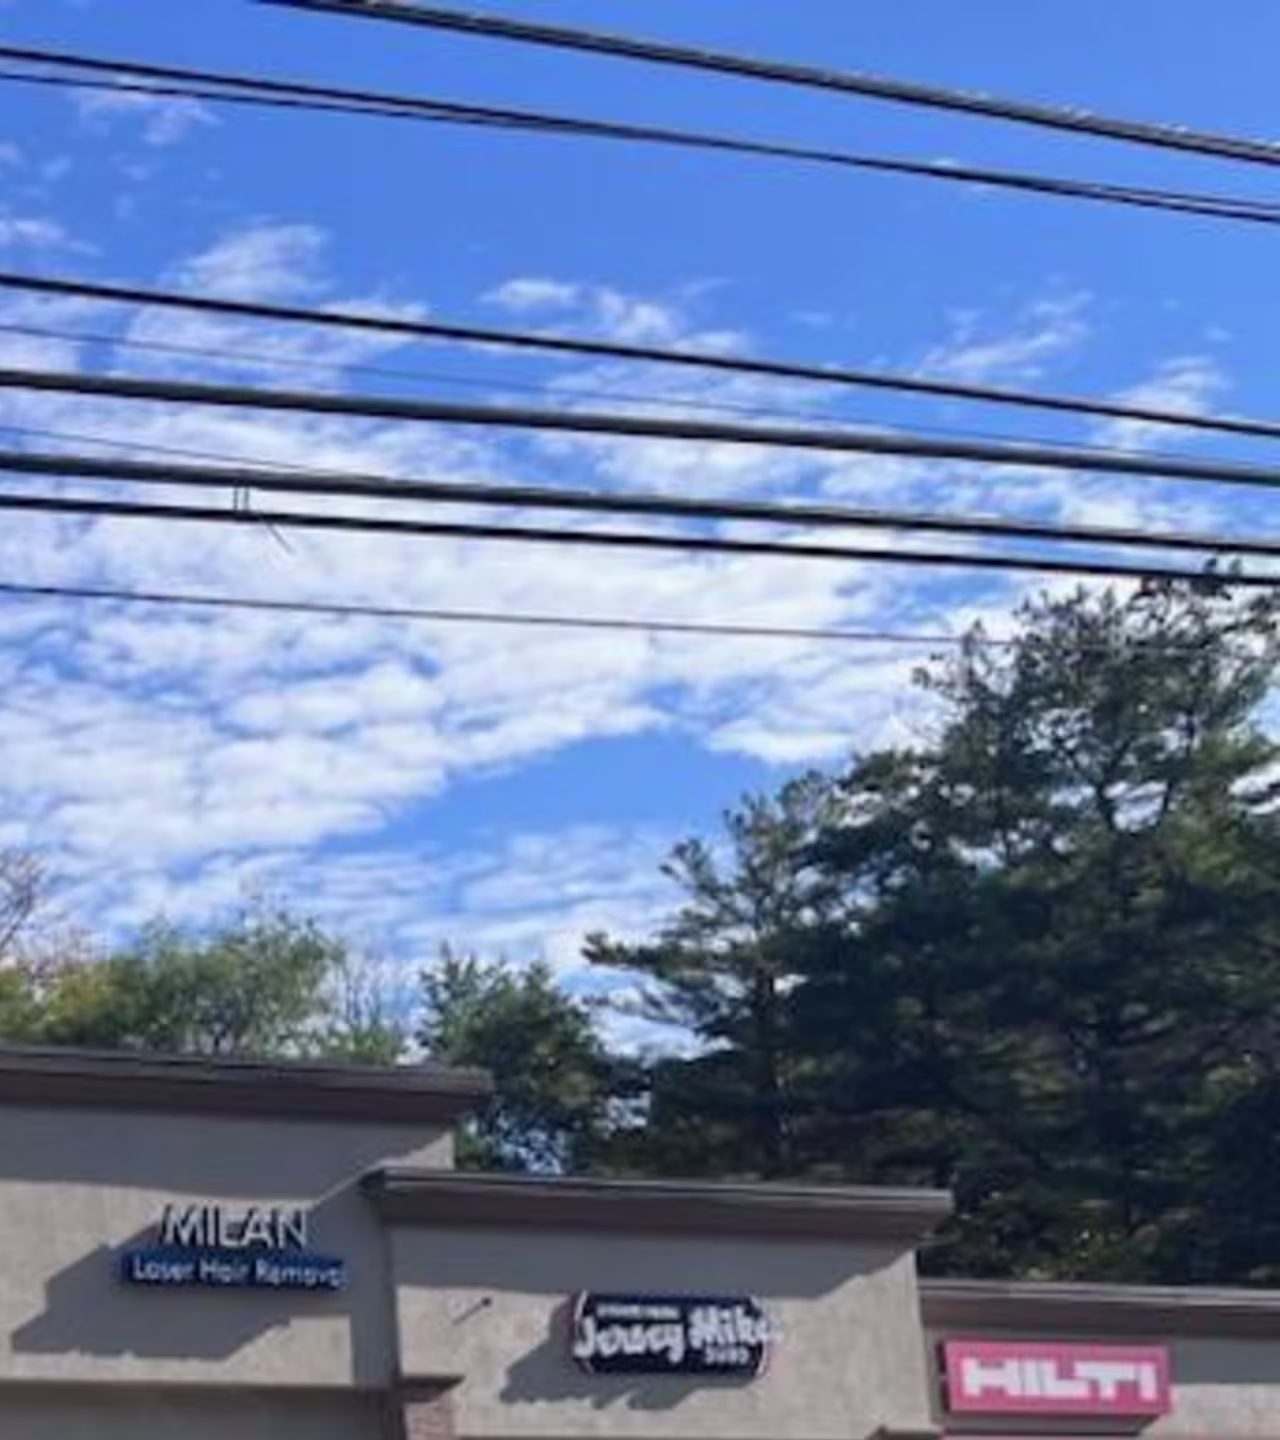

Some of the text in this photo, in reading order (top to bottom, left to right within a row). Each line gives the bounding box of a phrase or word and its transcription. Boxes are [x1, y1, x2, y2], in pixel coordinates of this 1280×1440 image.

[162, 1203, 308, 1249] MILAN
[132, 1256, 193, 1281] Laser
[198, 1258, 249, 1283] Hair
[574, 1316, 685, 1364] Jersey
[960, 1356, 1159, 1402] HILTI
